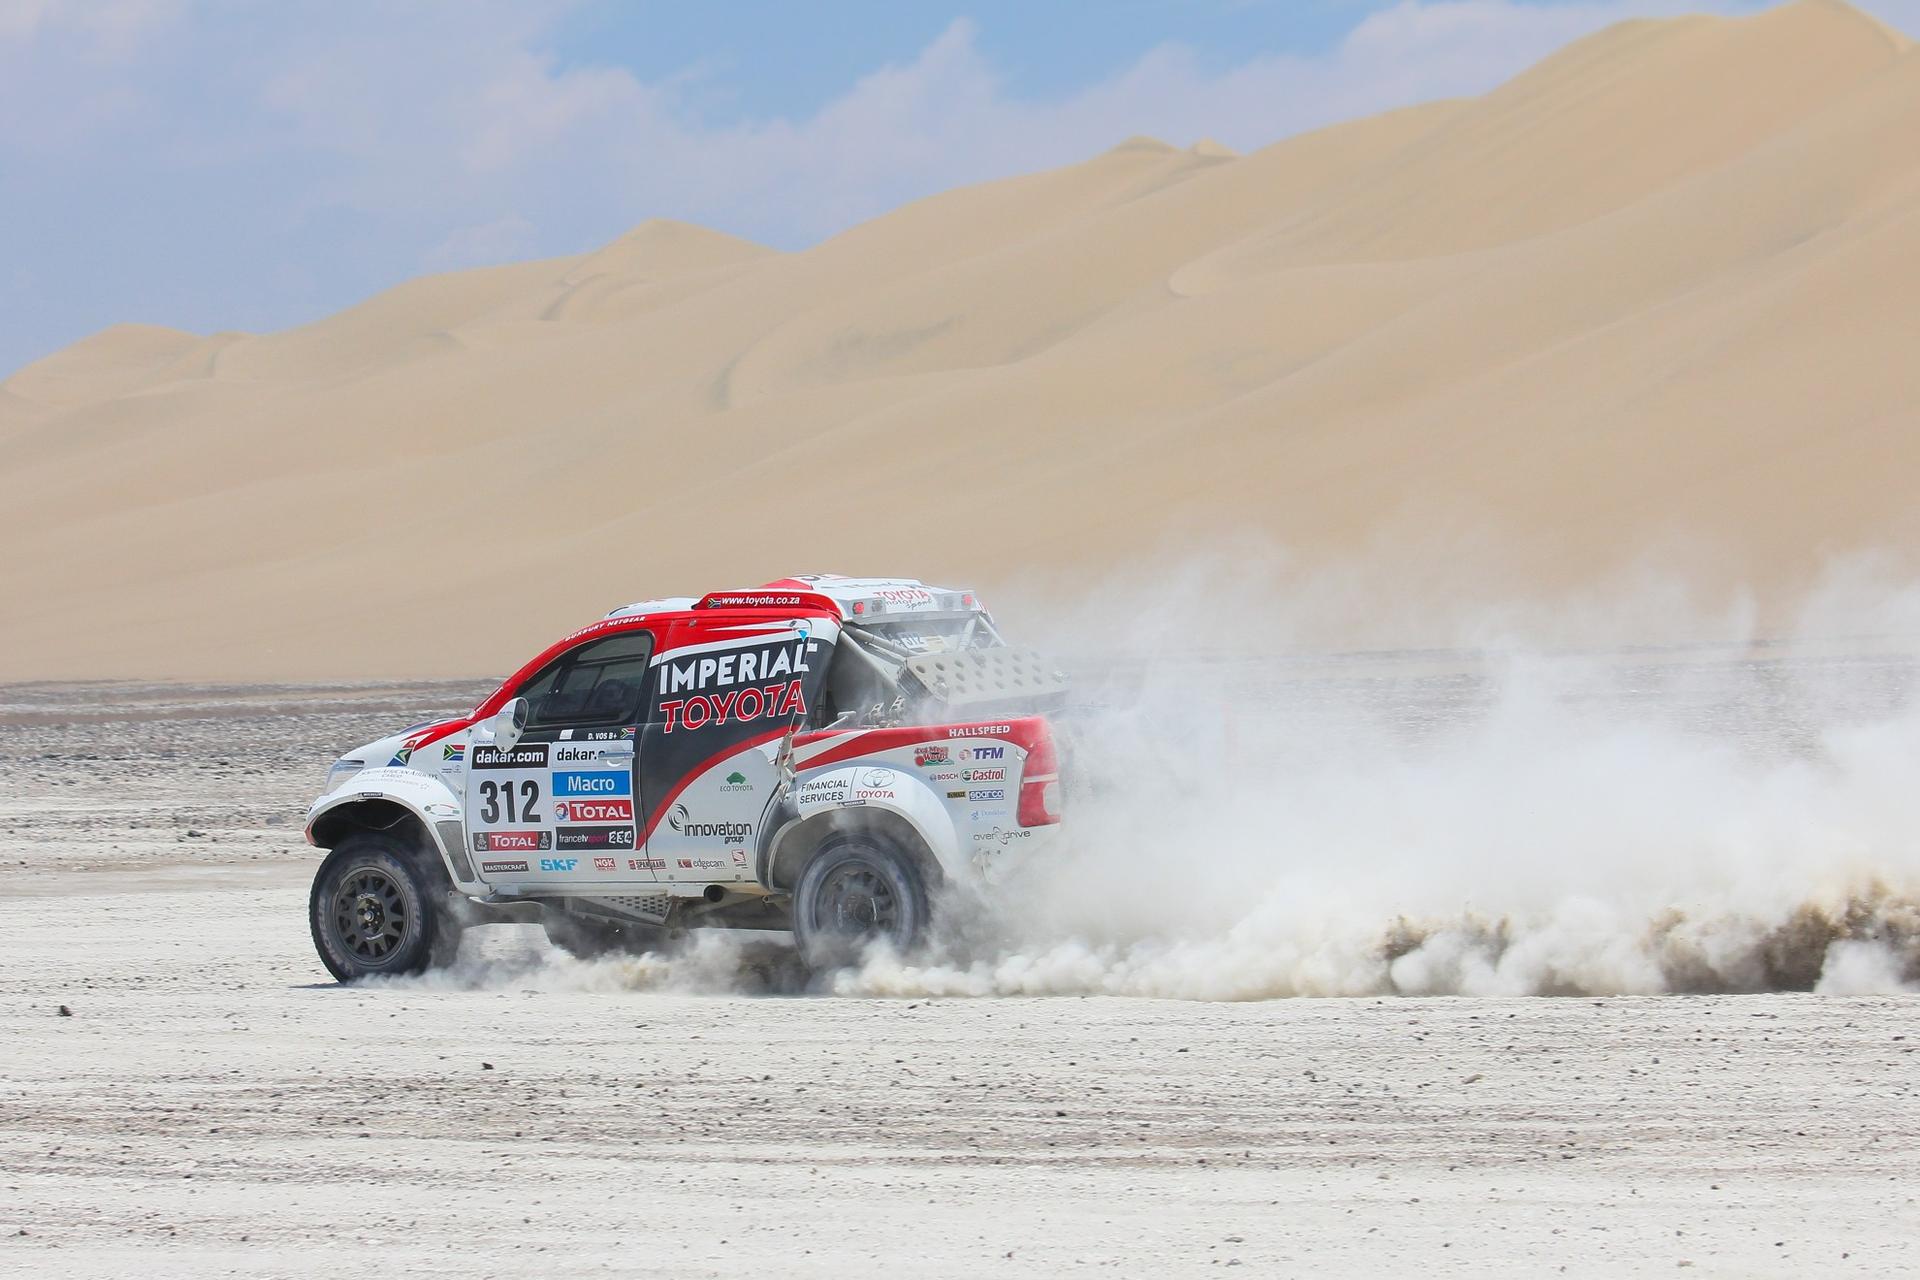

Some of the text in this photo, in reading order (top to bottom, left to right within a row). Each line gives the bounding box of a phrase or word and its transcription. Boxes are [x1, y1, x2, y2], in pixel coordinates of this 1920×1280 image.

[873, 589, 928, 600] TOYOTA
[721, 596, 800, 606] www.toyota.co.za
[659, 643, 810, 695] IMPERIAL
[659, 679, 807, 734] TOYOTA
[949, 725, 1010, 737] HALLSPEED
[476, 750, 544, 764] dakar.com
[973, 747, 1004, 760] TFM
[972, 769, 1004, 781] Castrol
[567, 776, 615, 792] Macro
[719, 784, 731, 792] ECO
[801, 780, 848, 793] FINANCIAL
[800, 791, 844, 804] SERVICES
[856, 790, 894, 798] TOYOTA
[970, 790, 1003, 799] sparco
[479, 780, 541, 824] 312
[571, 803, 630, 819] TOTAL
[684, 822, 752, 836] innovation
[491, 835, 536, 847] TOTAL
[724, 836, 744, 844] group
[540, 859, 578, 871] SKF
[594, 859, 615, 867] NGK
[693, 858, 726, 869] edgecam
